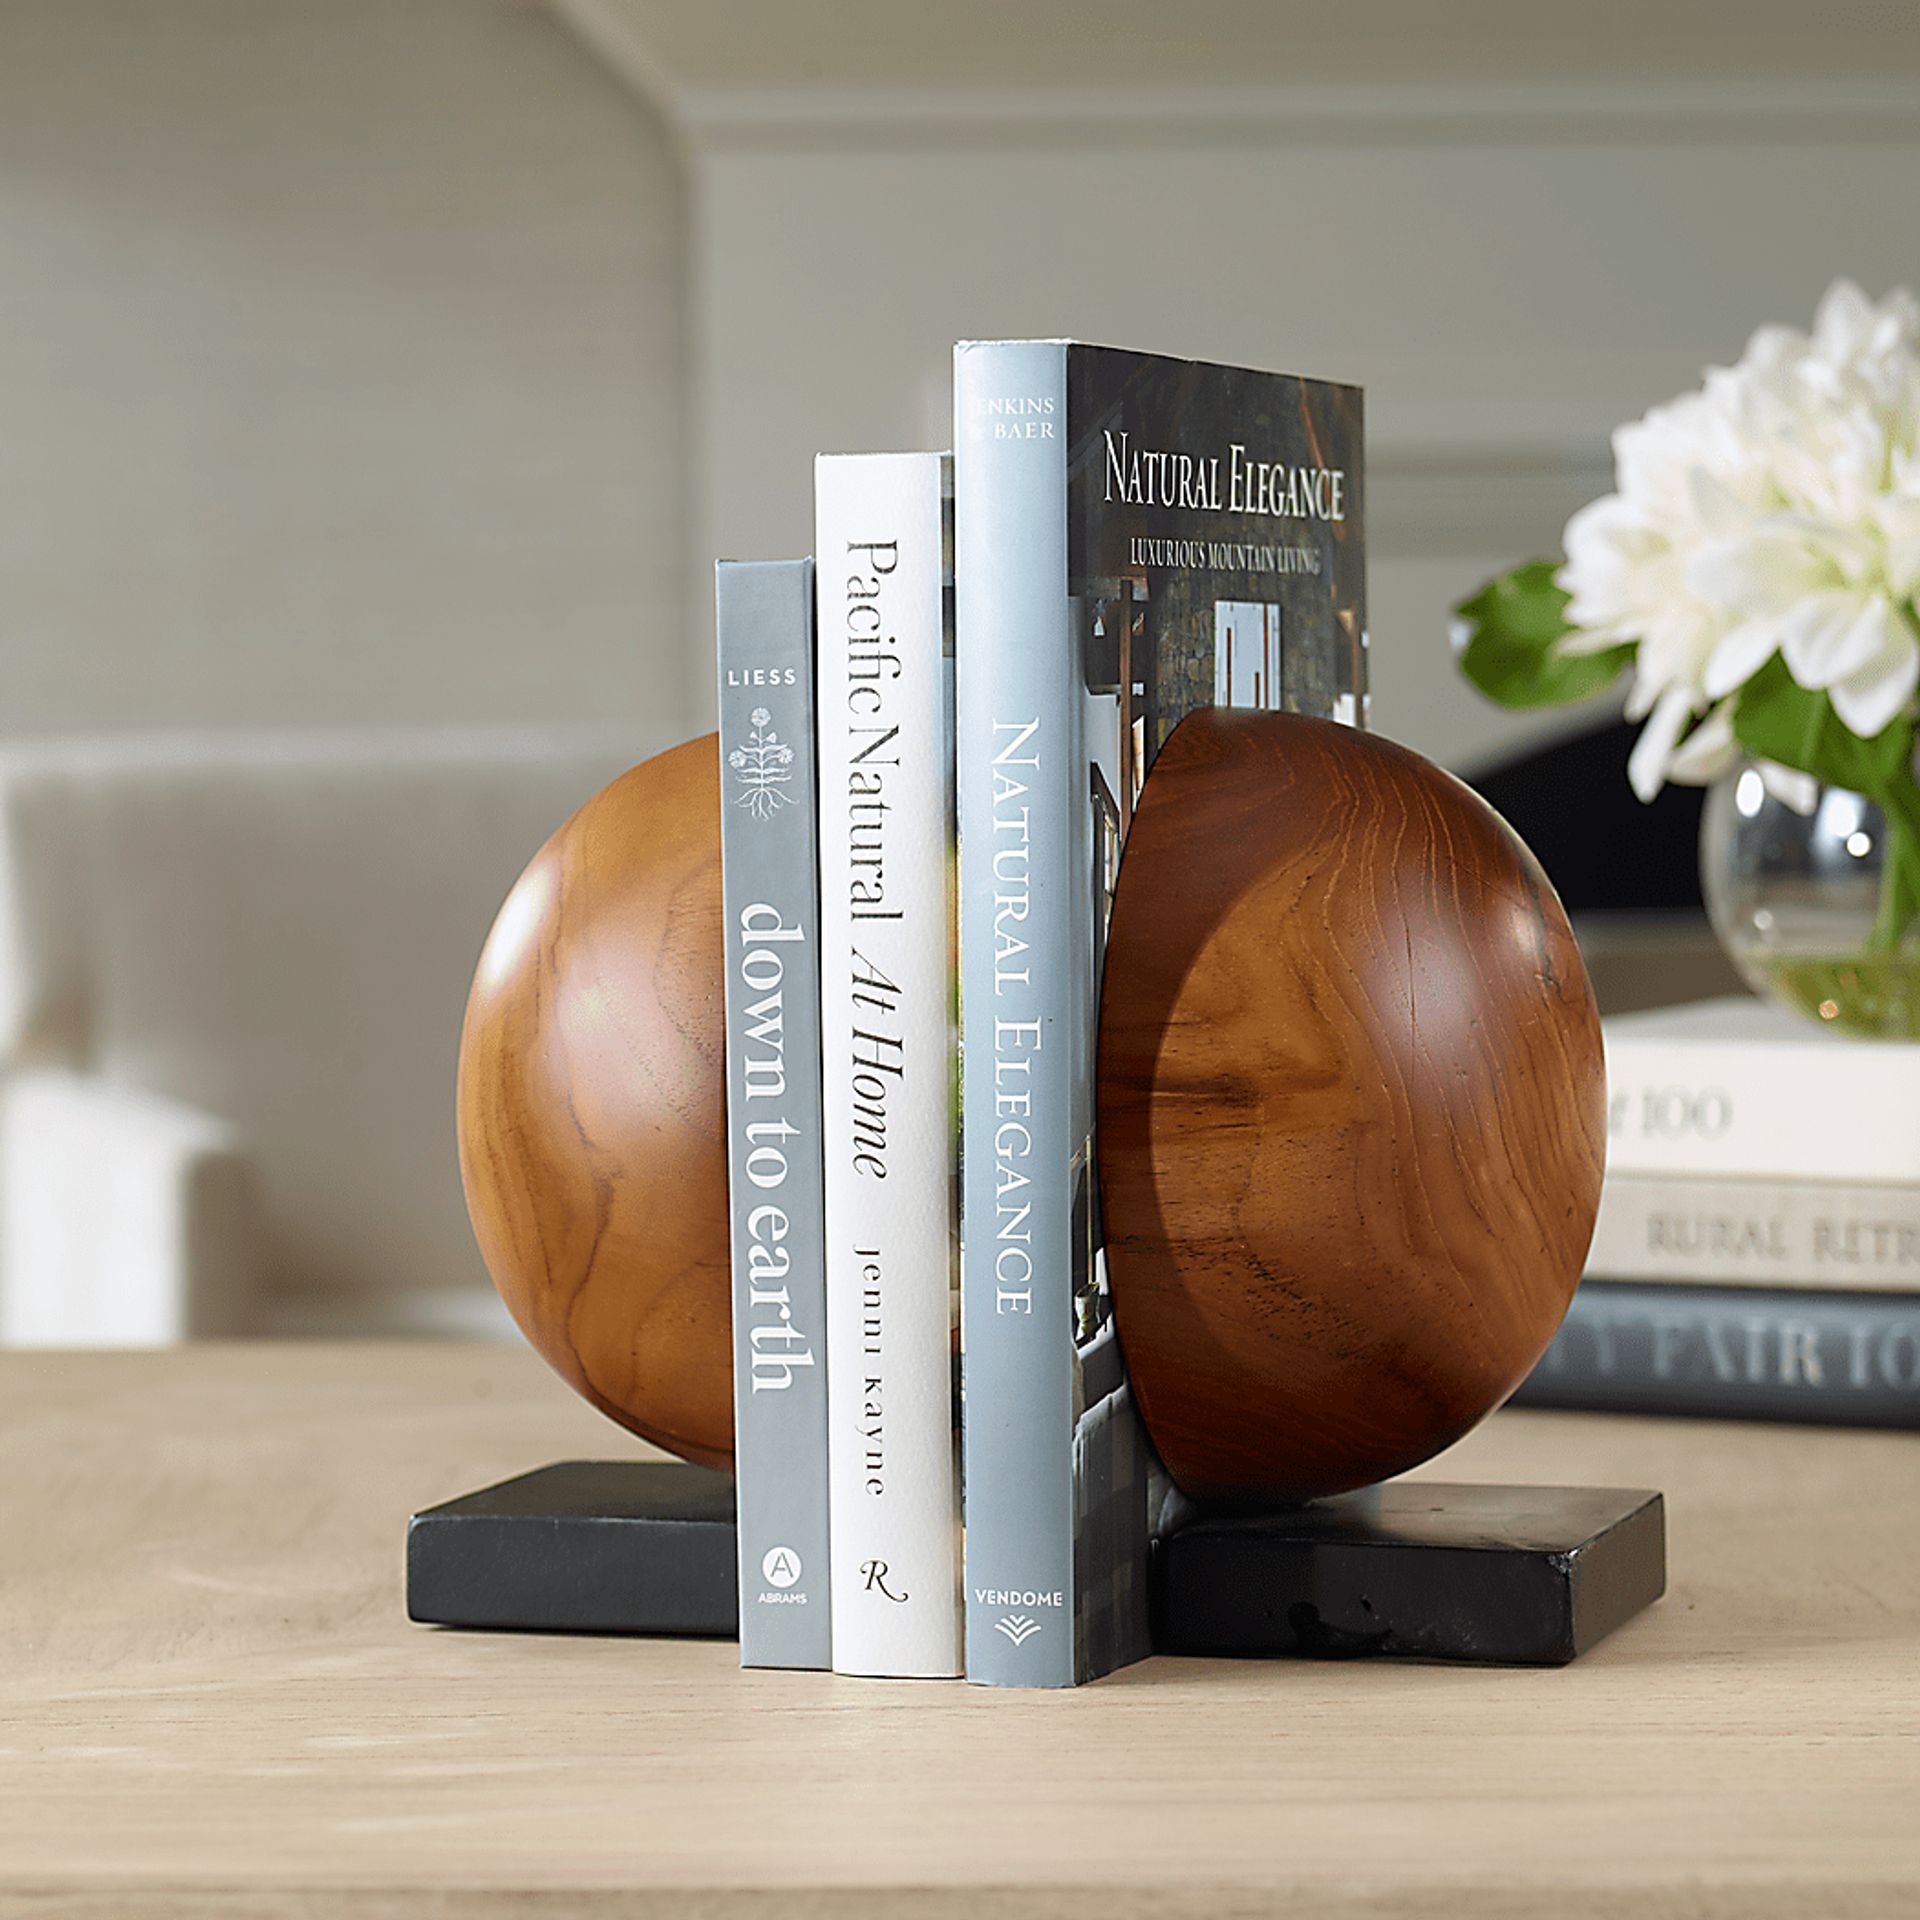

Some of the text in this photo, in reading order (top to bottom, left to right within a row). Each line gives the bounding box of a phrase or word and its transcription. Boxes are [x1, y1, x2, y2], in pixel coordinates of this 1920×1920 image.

[994, 421, 1055, 440] BAER
[1130, 537, 1322, 576] LUXURIOUS MOUNTAIN LIVING
[727, 668, 797, 687] LIESS
[846, 539, 905, 1180] Pacific Natural At Home
[991, 717, 1042, 1316] NATURAL ELEGANCE
[740, 902, 815, 1395] down to earth
[1647, 1213, 1788, 1262] RURAL
[758, 1592, 807, 1604] ABRAMS
[859, 1560, 909, 1603] R
[974, 1589, 1063, 1607] VENDOME
